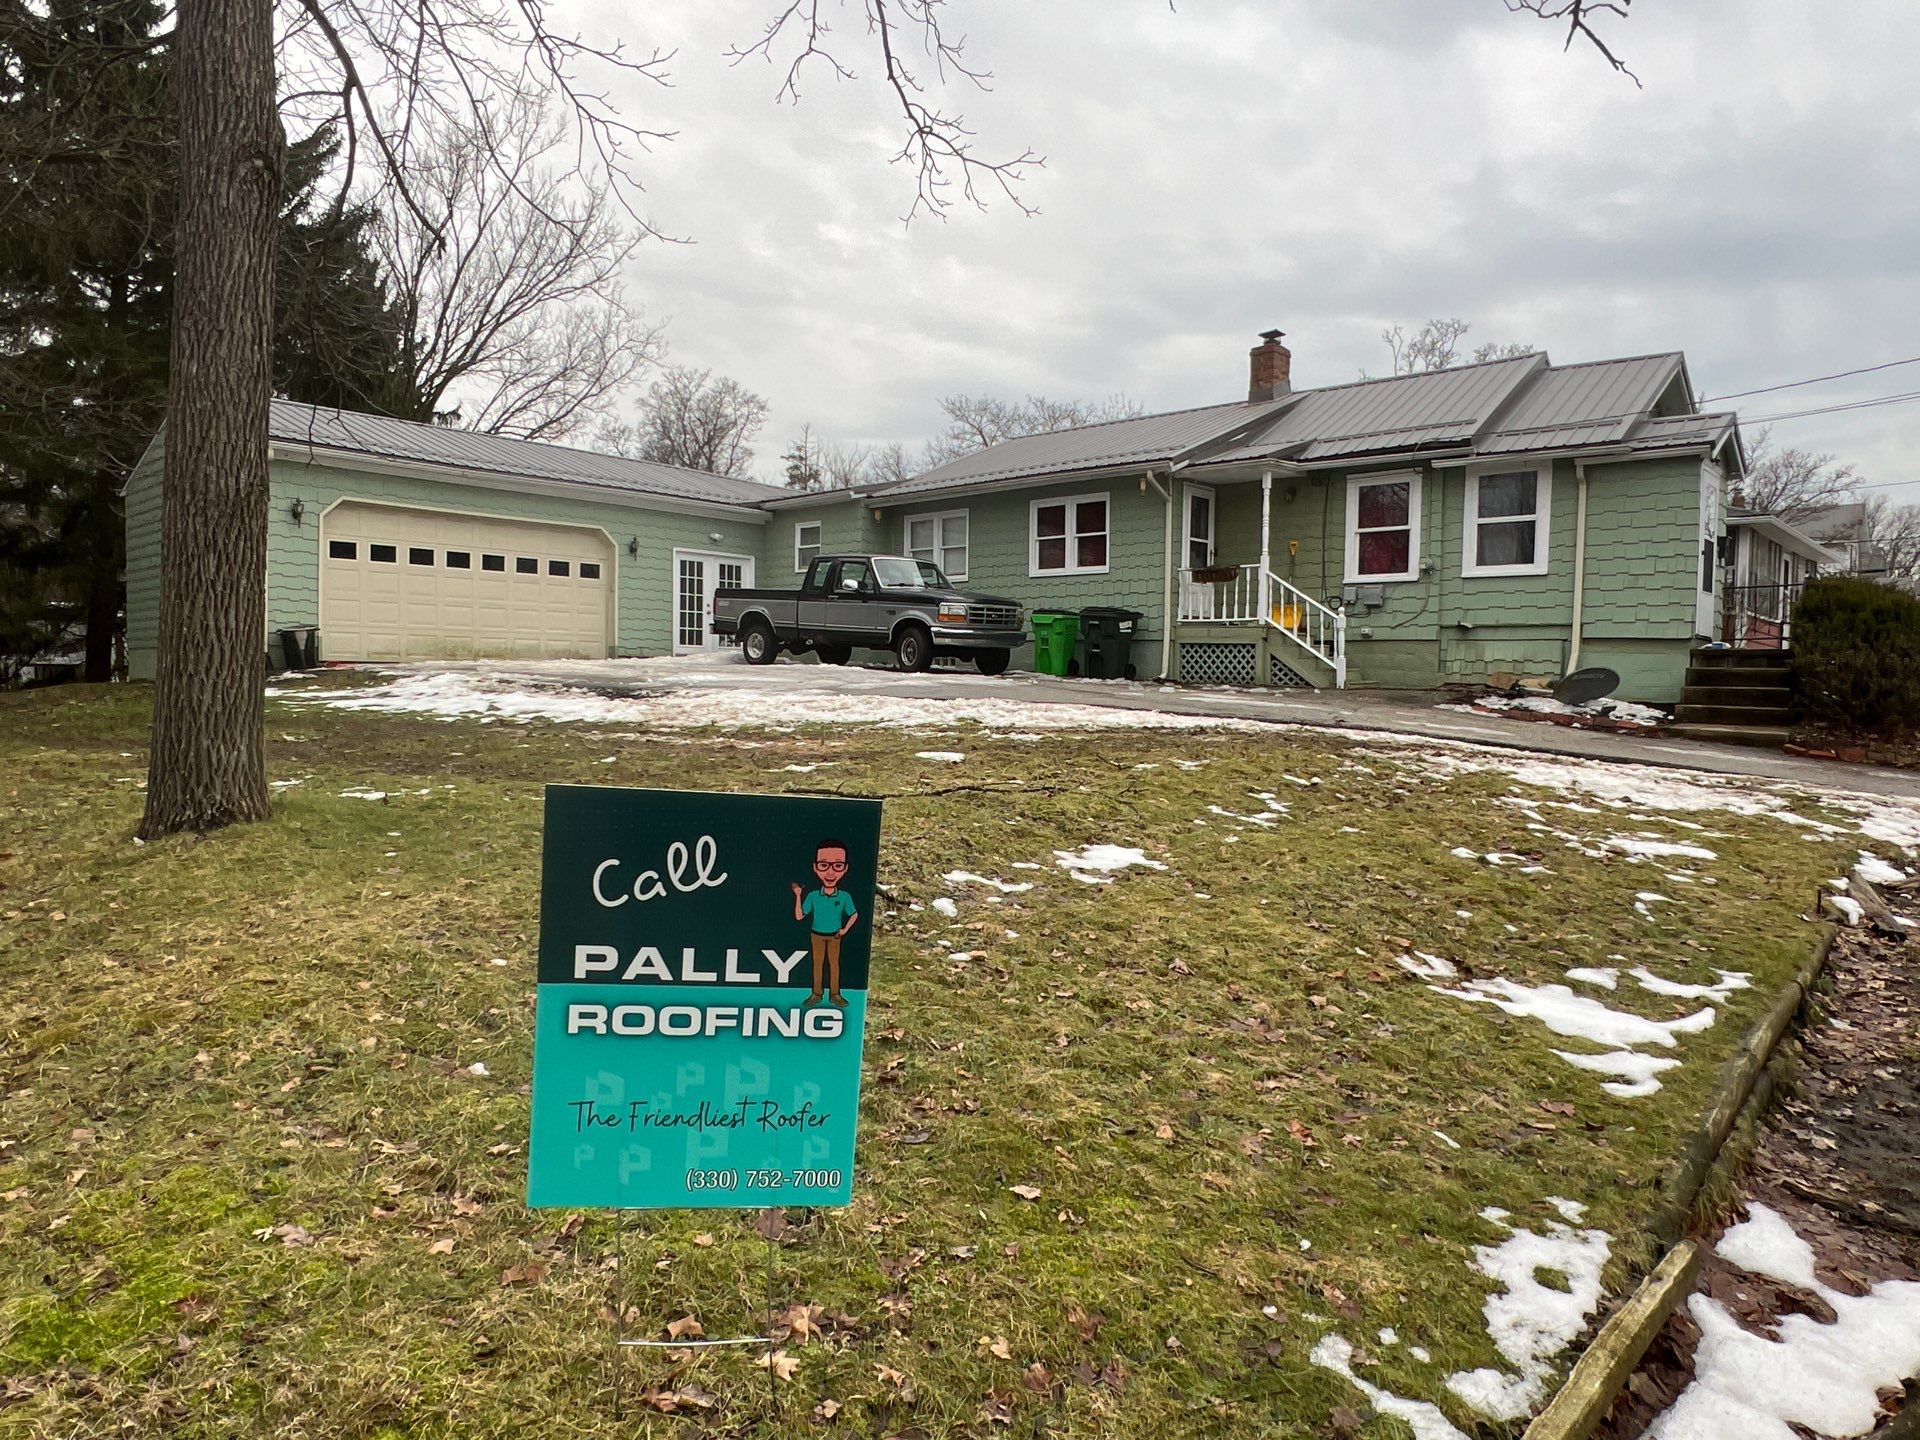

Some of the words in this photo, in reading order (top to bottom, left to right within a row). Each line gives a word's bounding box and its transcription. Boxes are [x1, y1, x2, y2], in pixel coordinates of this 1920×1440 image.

[593, 835, 728, 907] Call
[573, 944, 809, 984] PALLY
[567, 1004, 844, 1038] ROOFING
[568, 1100, 622, 1133] The
[629, 1096, 757, 1133] Friendliest
[756, 1101, 831, 1133] Roofer
[686, 1168, 739, 1192] (330)
[745, 1168, 842, 1189] 752-7000
